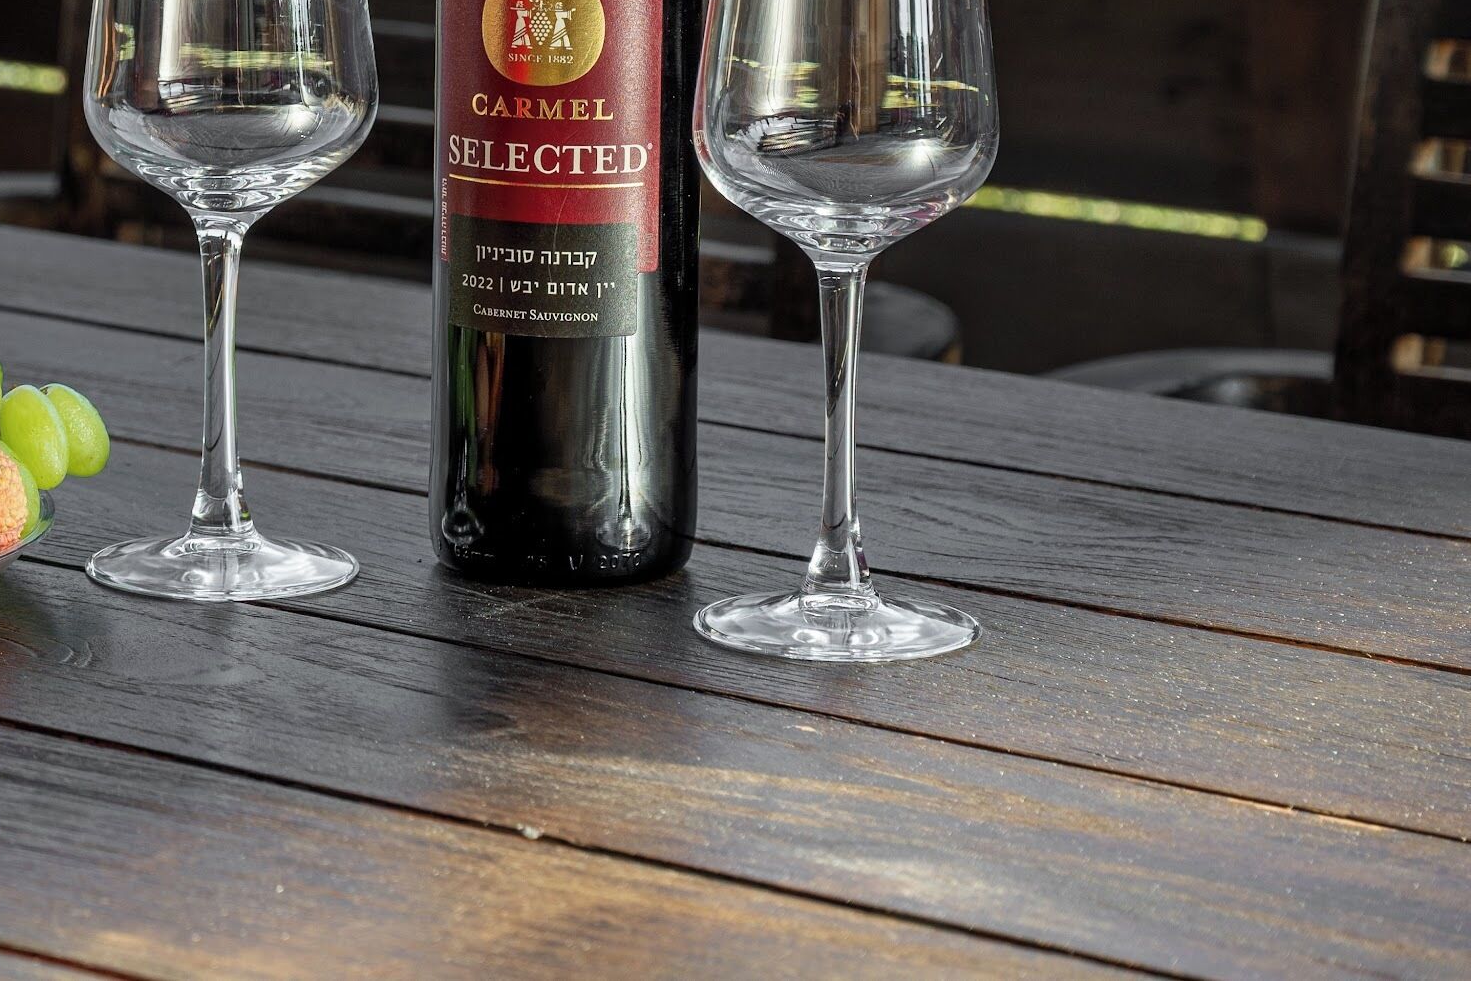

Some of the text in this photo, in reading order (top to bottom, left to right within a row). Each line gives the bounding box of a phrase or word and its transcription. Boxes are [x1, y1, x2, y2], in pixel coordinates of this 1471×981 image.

[508, 53, 574, 64] SINCE 1882
[471, 93, 614, 121] CARMEL
[448, 134, 648, 175] SELECTED
[475, 245, 598, 269] קברנה סוביניון
[462, 274, 494, 290] 2022
[510, 279, 539, 294] יבש
[547, 281, 589, 296] אדום
[596, 282, 616, 299] יין
